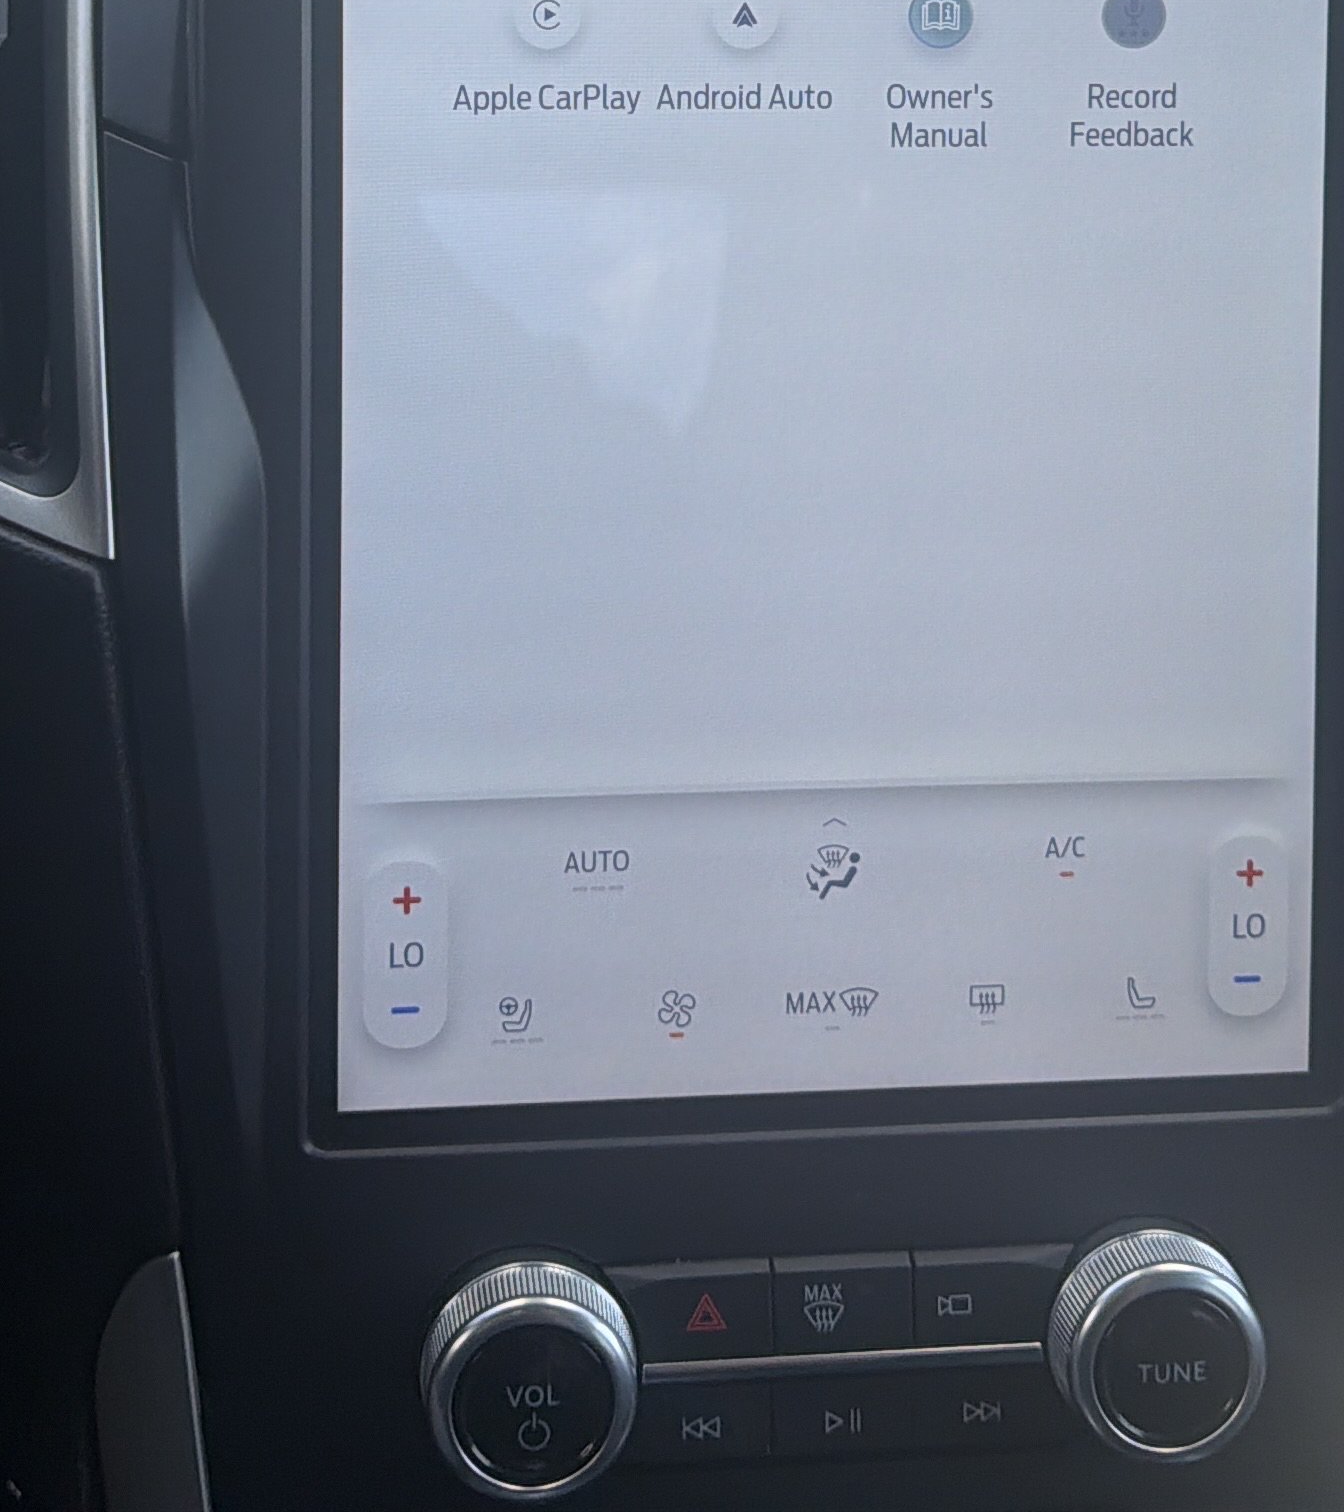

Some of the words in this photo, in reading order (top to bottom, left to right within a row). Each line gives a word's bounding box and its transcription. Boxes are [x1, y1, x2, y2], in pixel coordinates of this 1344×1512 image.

[452, 83, 532, 116] Apple
[538, 83, 642, 116] CarPlay
[656, 82, 762, 111] Android
[767, 83, 833, 110] Auto
[886, 82, 994, 110] Owner's
[1087, 81, 1177, 109] Record
[890, 120, 988, 149] Manual
[1070, 119, 1194, 147] Feedback
[1044, 836, 1086, 860] A/C
[563, 849, 630, 875] AUTO
[1232, 913, 1267, 940] LO
[389, 941, 424, 969] LO
[785, 990, 836, 1016] MAX
[804, 1283, 843, 1302] MAX
[1137, 1360, 1208, 1384] TUNE
[505, 1384, 561, 1408] VOL
